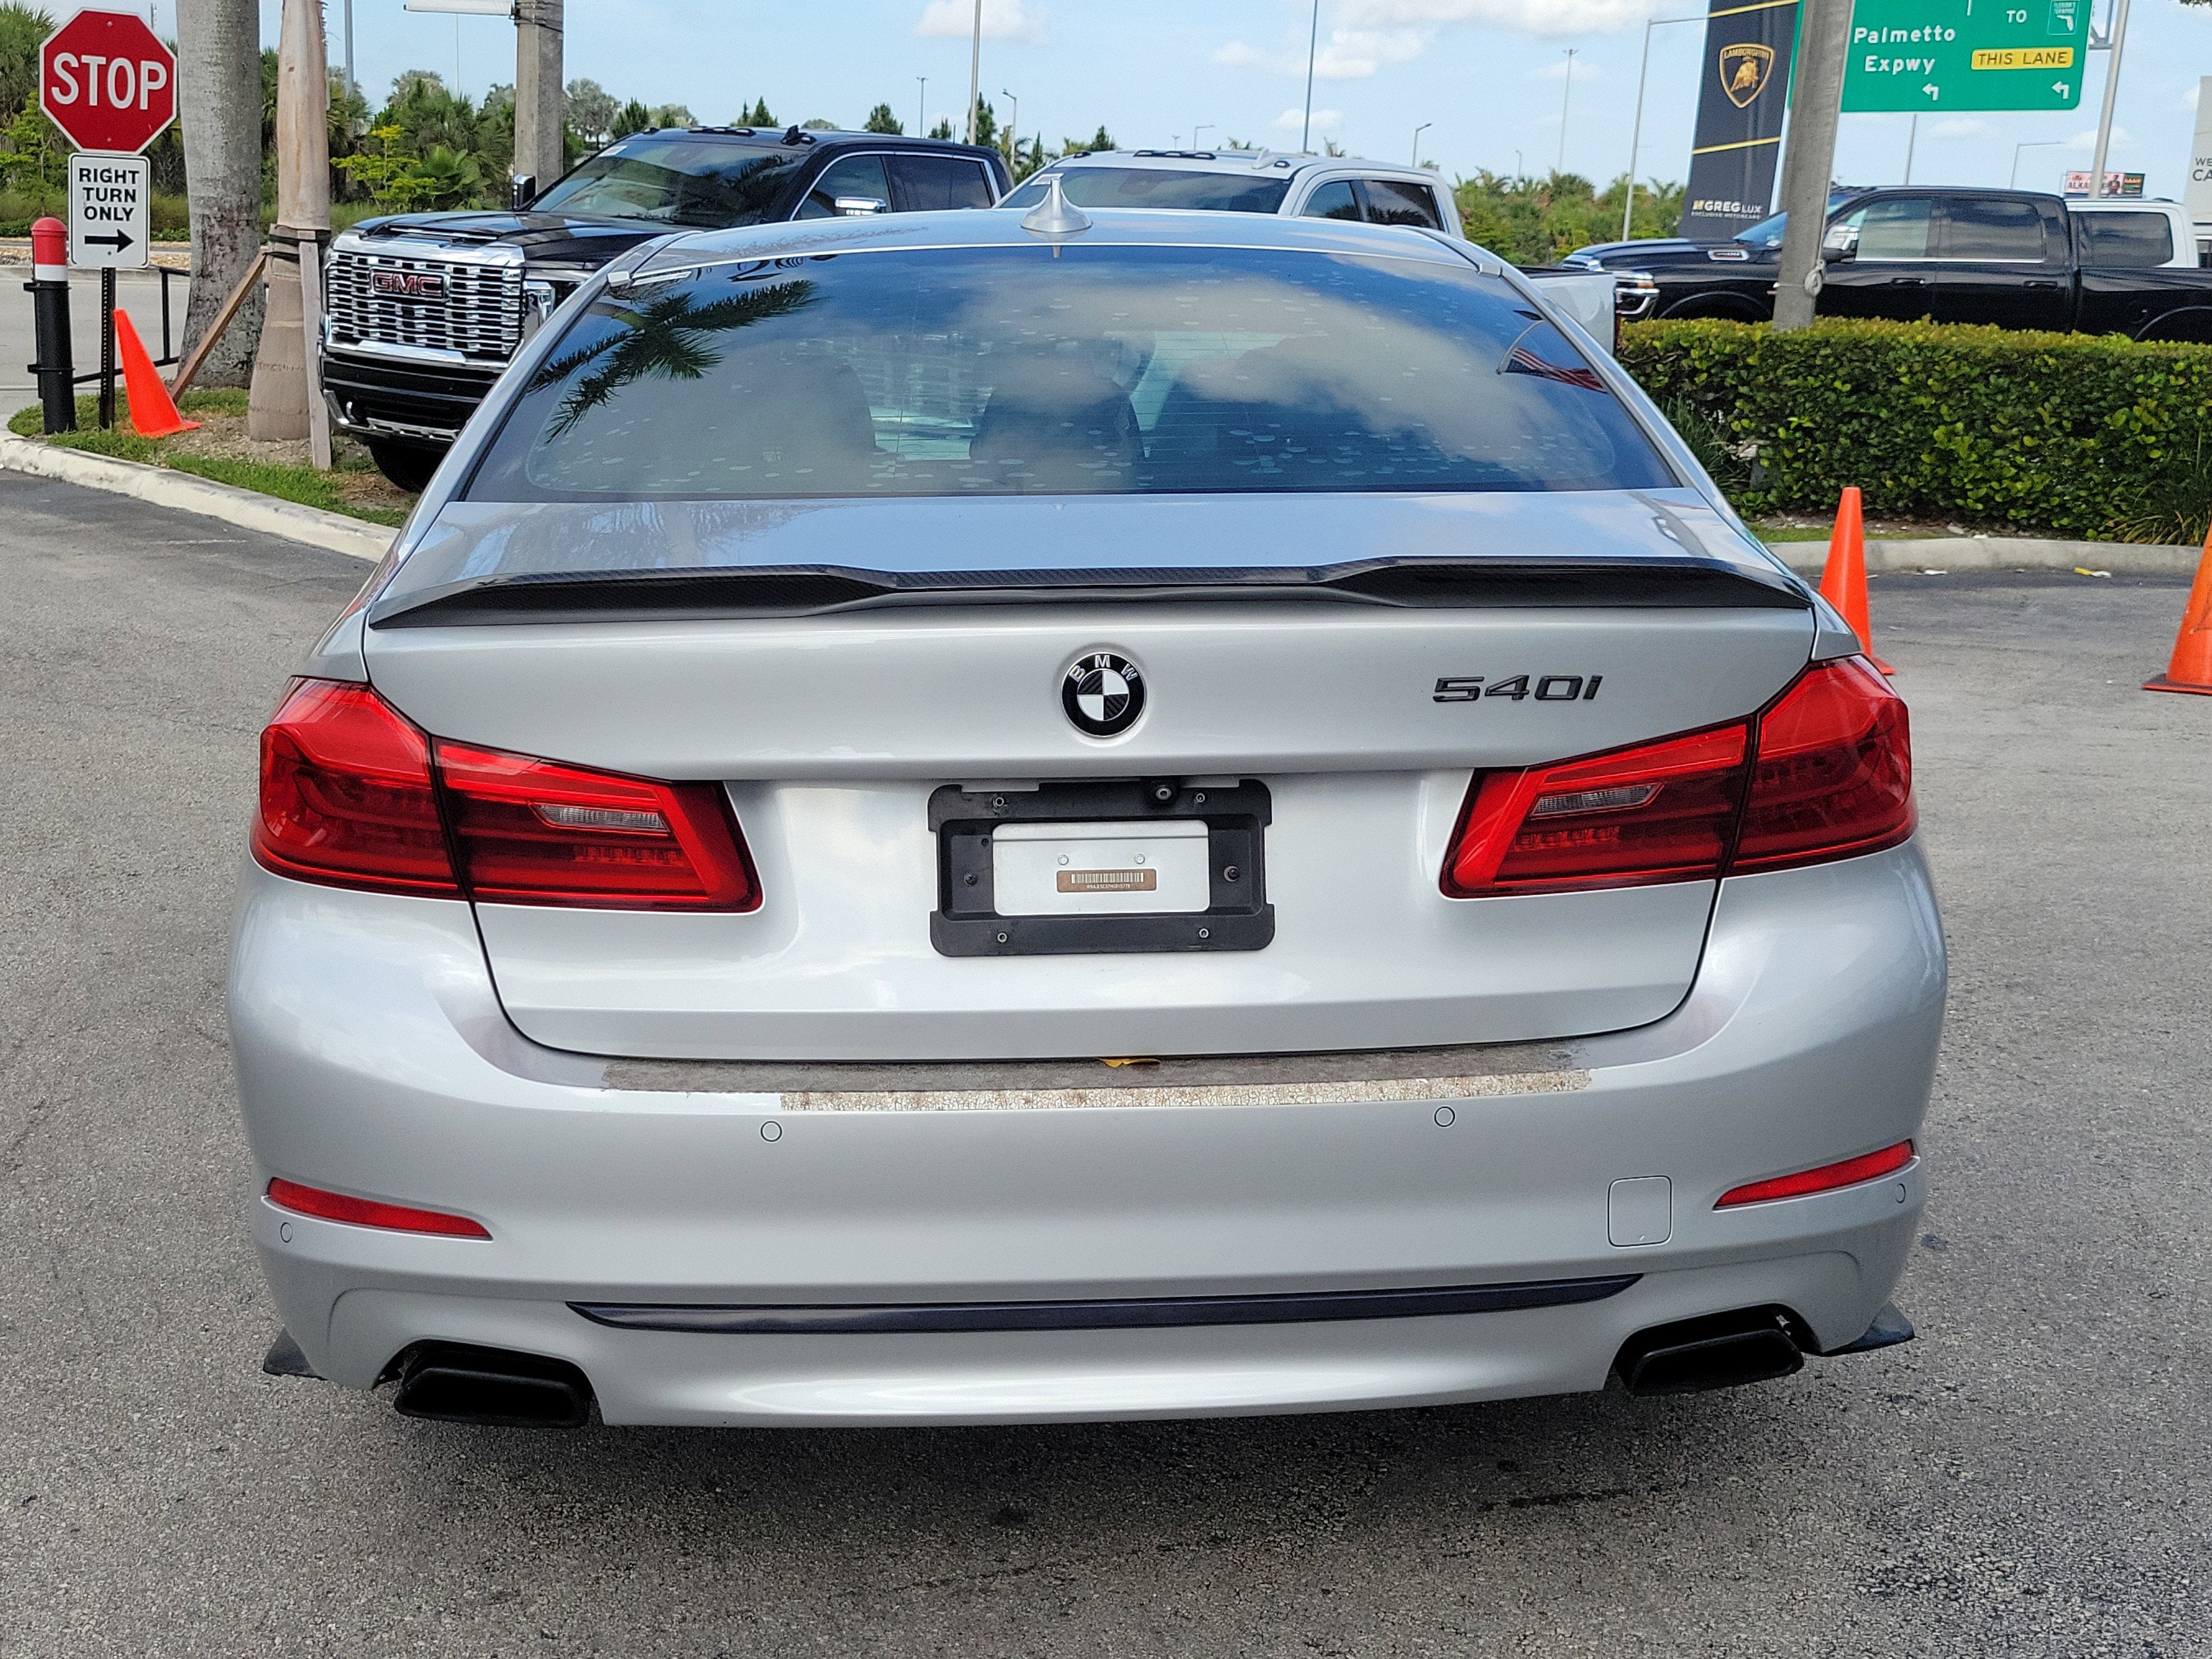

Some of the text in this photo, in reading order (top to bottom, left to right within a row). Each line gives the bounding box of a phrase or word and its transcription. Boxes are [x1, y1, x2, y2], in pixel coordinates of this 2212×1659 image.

[2006, 9, 2027, 23] TO
[1854, 25, 1956, 44] Palmetto
[1865, 55, 1936, 75] Expwy
[1978, 52, 2068, 66] THIS LANE
[52, 52, 167, 110] STOP
[2195, 157, 2212, 166] WE
[79, 167, 140, 184] RIGHT
[83, 187, 136, 203] TURN
[84, 206, 134, 222] ONLY
[373, 272, 442, 297] GMC
[1069, 654, 1138, 683] BMW
